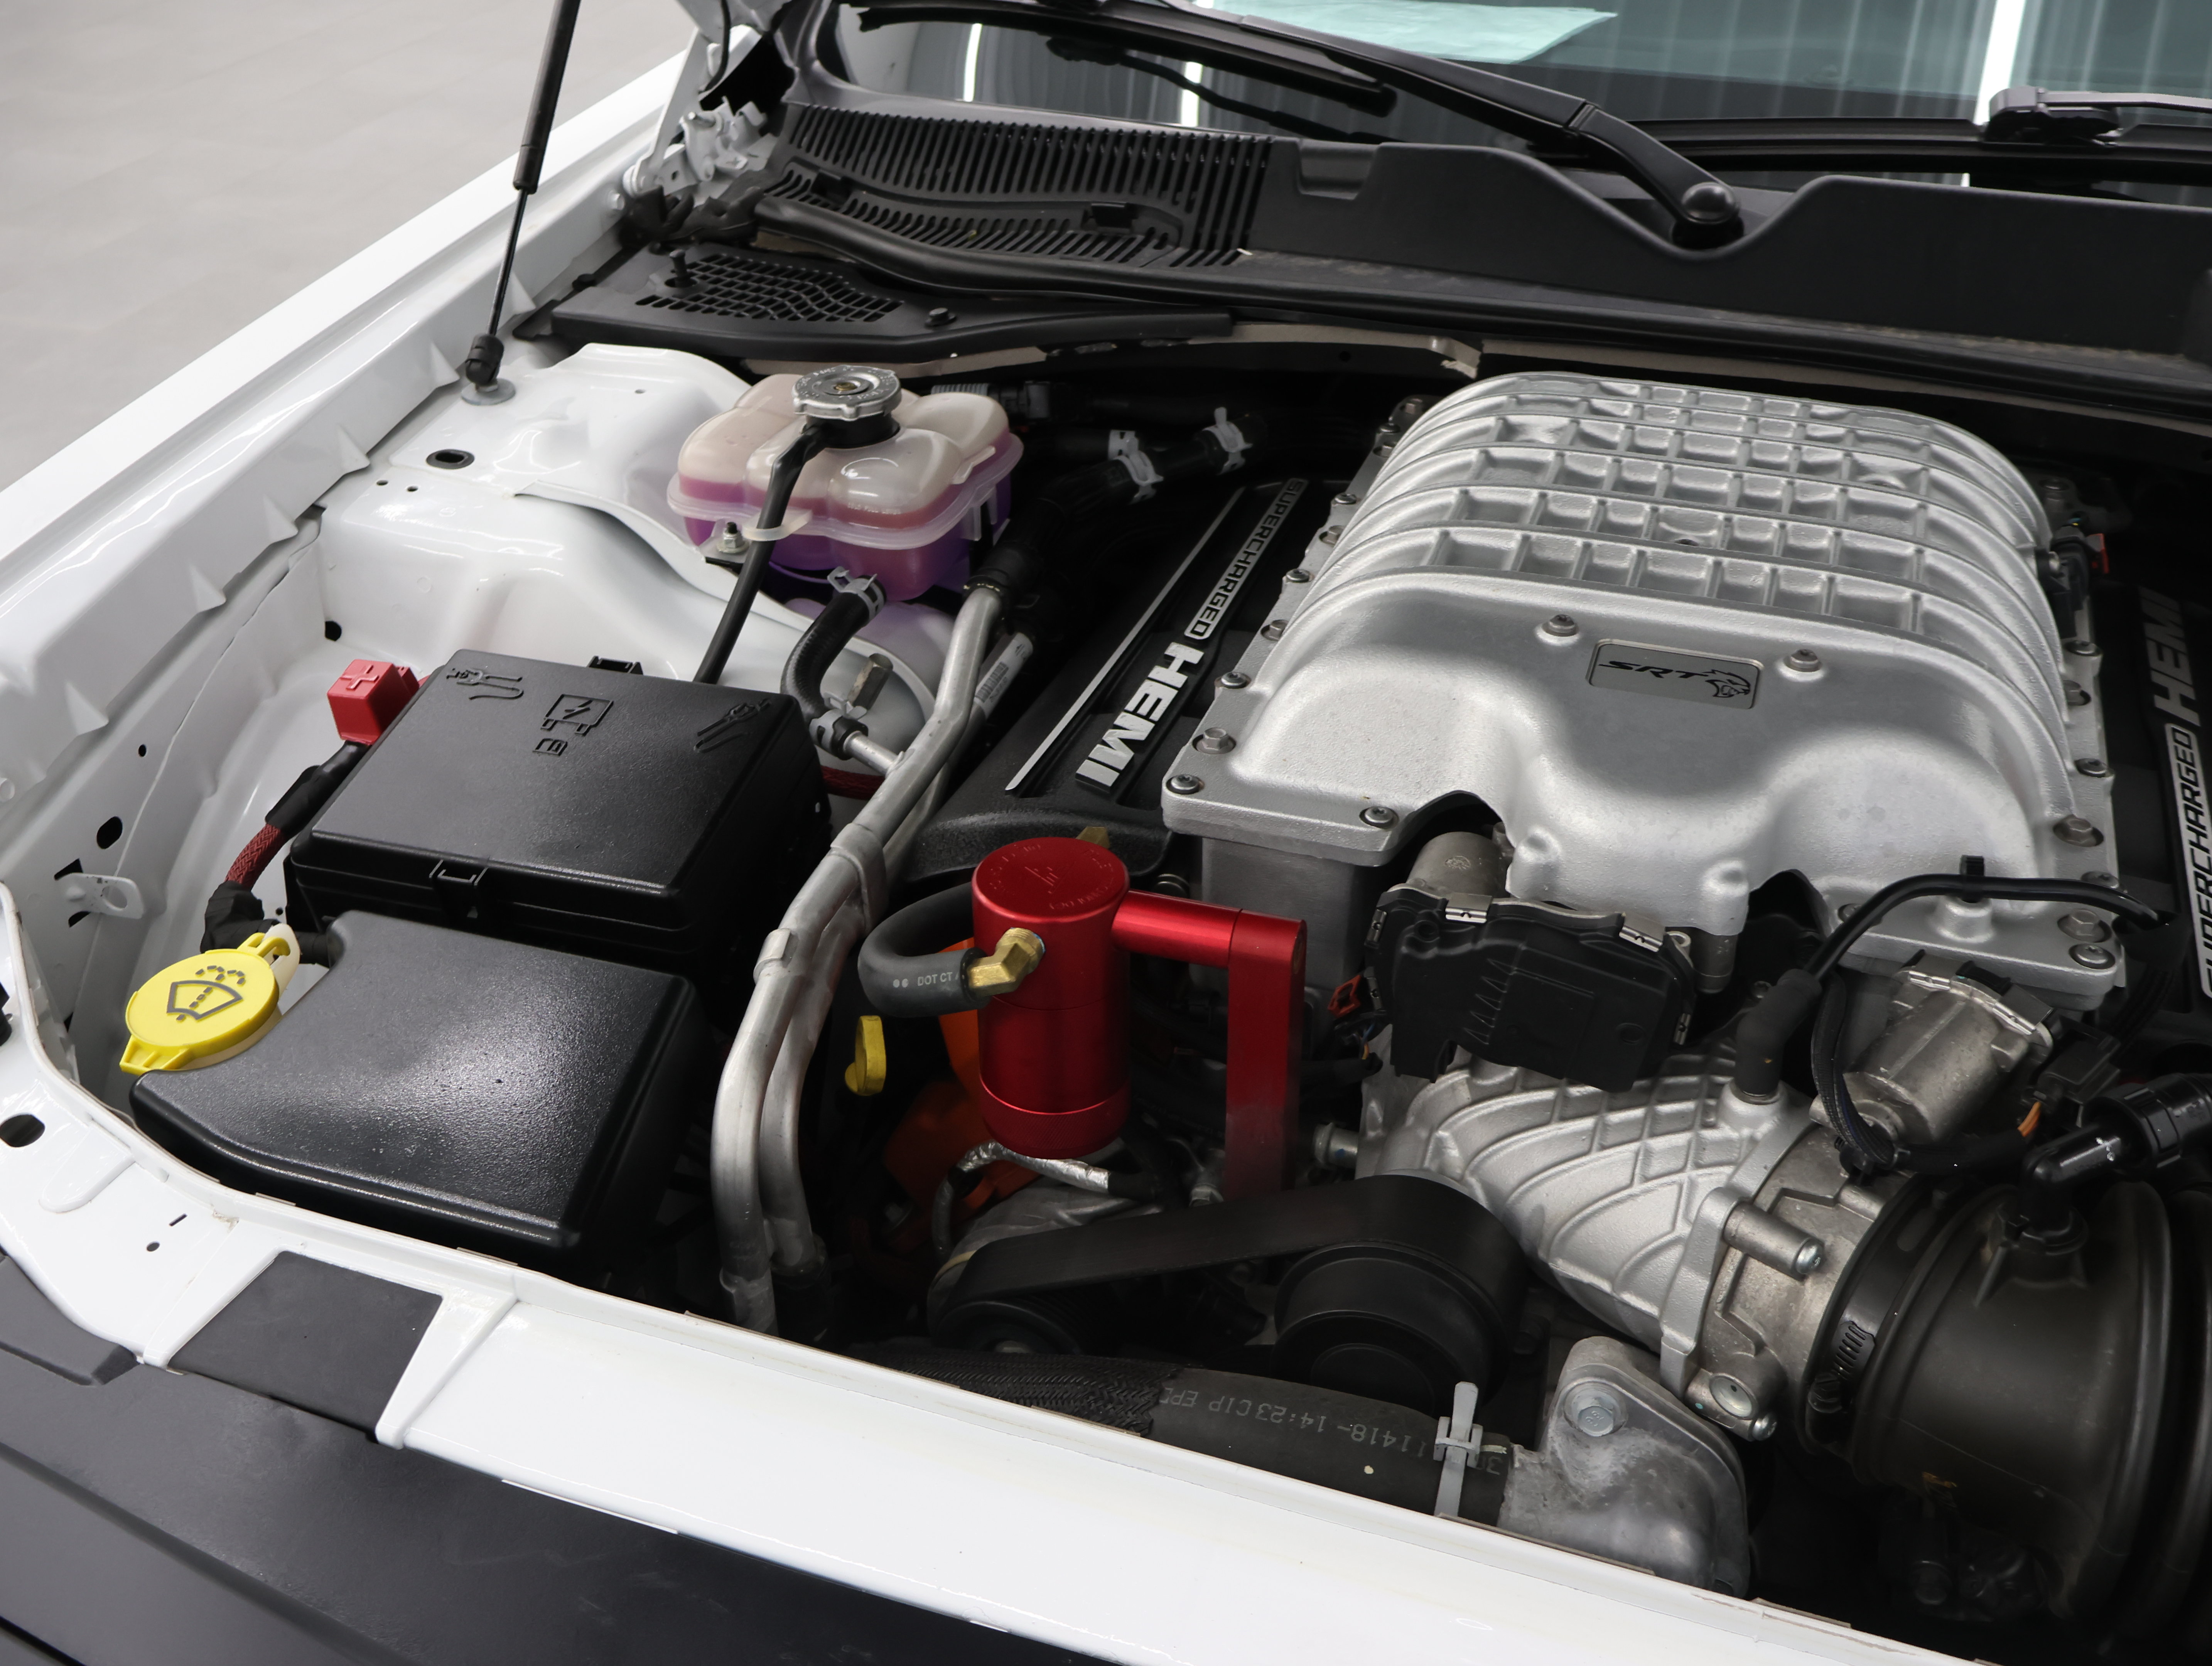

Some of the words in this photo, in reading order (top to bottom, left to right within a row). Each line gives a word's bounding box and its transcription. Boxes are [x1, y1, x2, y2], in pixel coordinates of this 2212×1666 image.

[1190, 481, 1304, 637] SUPERCHARGED
[1075, 642, 1205, 787] HEMI
[1598, 661, 1709, 678] SRT
[2138, 585, 2201, 727] HEMI
[2171, 727, 2212, 992] PERCHARGED
[917, 974, 938, 986] DOT
[940, 971, 953, 983] CT
